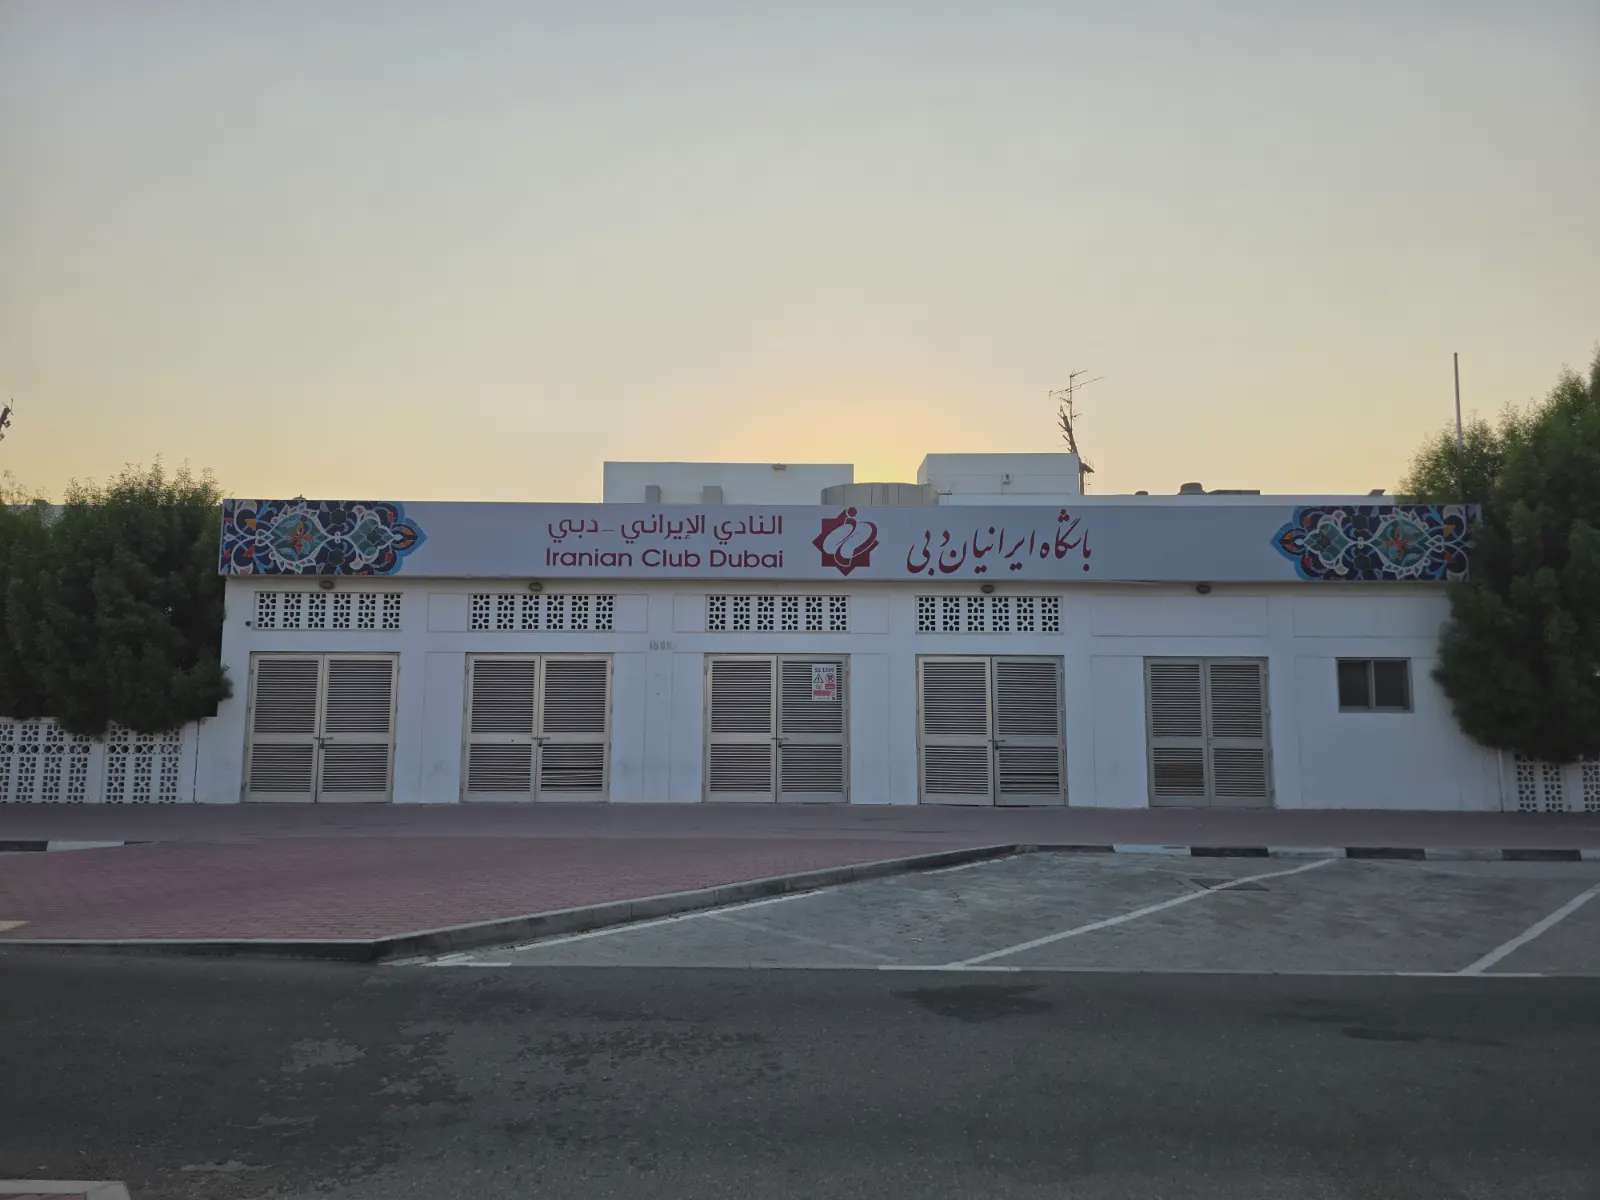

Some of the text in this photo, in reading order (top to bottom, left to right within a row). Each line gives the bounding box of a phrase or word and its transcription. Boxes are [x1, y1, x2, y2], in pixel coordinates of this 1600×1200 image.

[547, 518, 599, 544] دبي
[620, 513, 706, 545] الإيراني
[712, 514, 784, 545] النادي
[1038, 508, 1092, 572] باشگاه
[545, 548, 784, 569] Iranian Club Dubai
